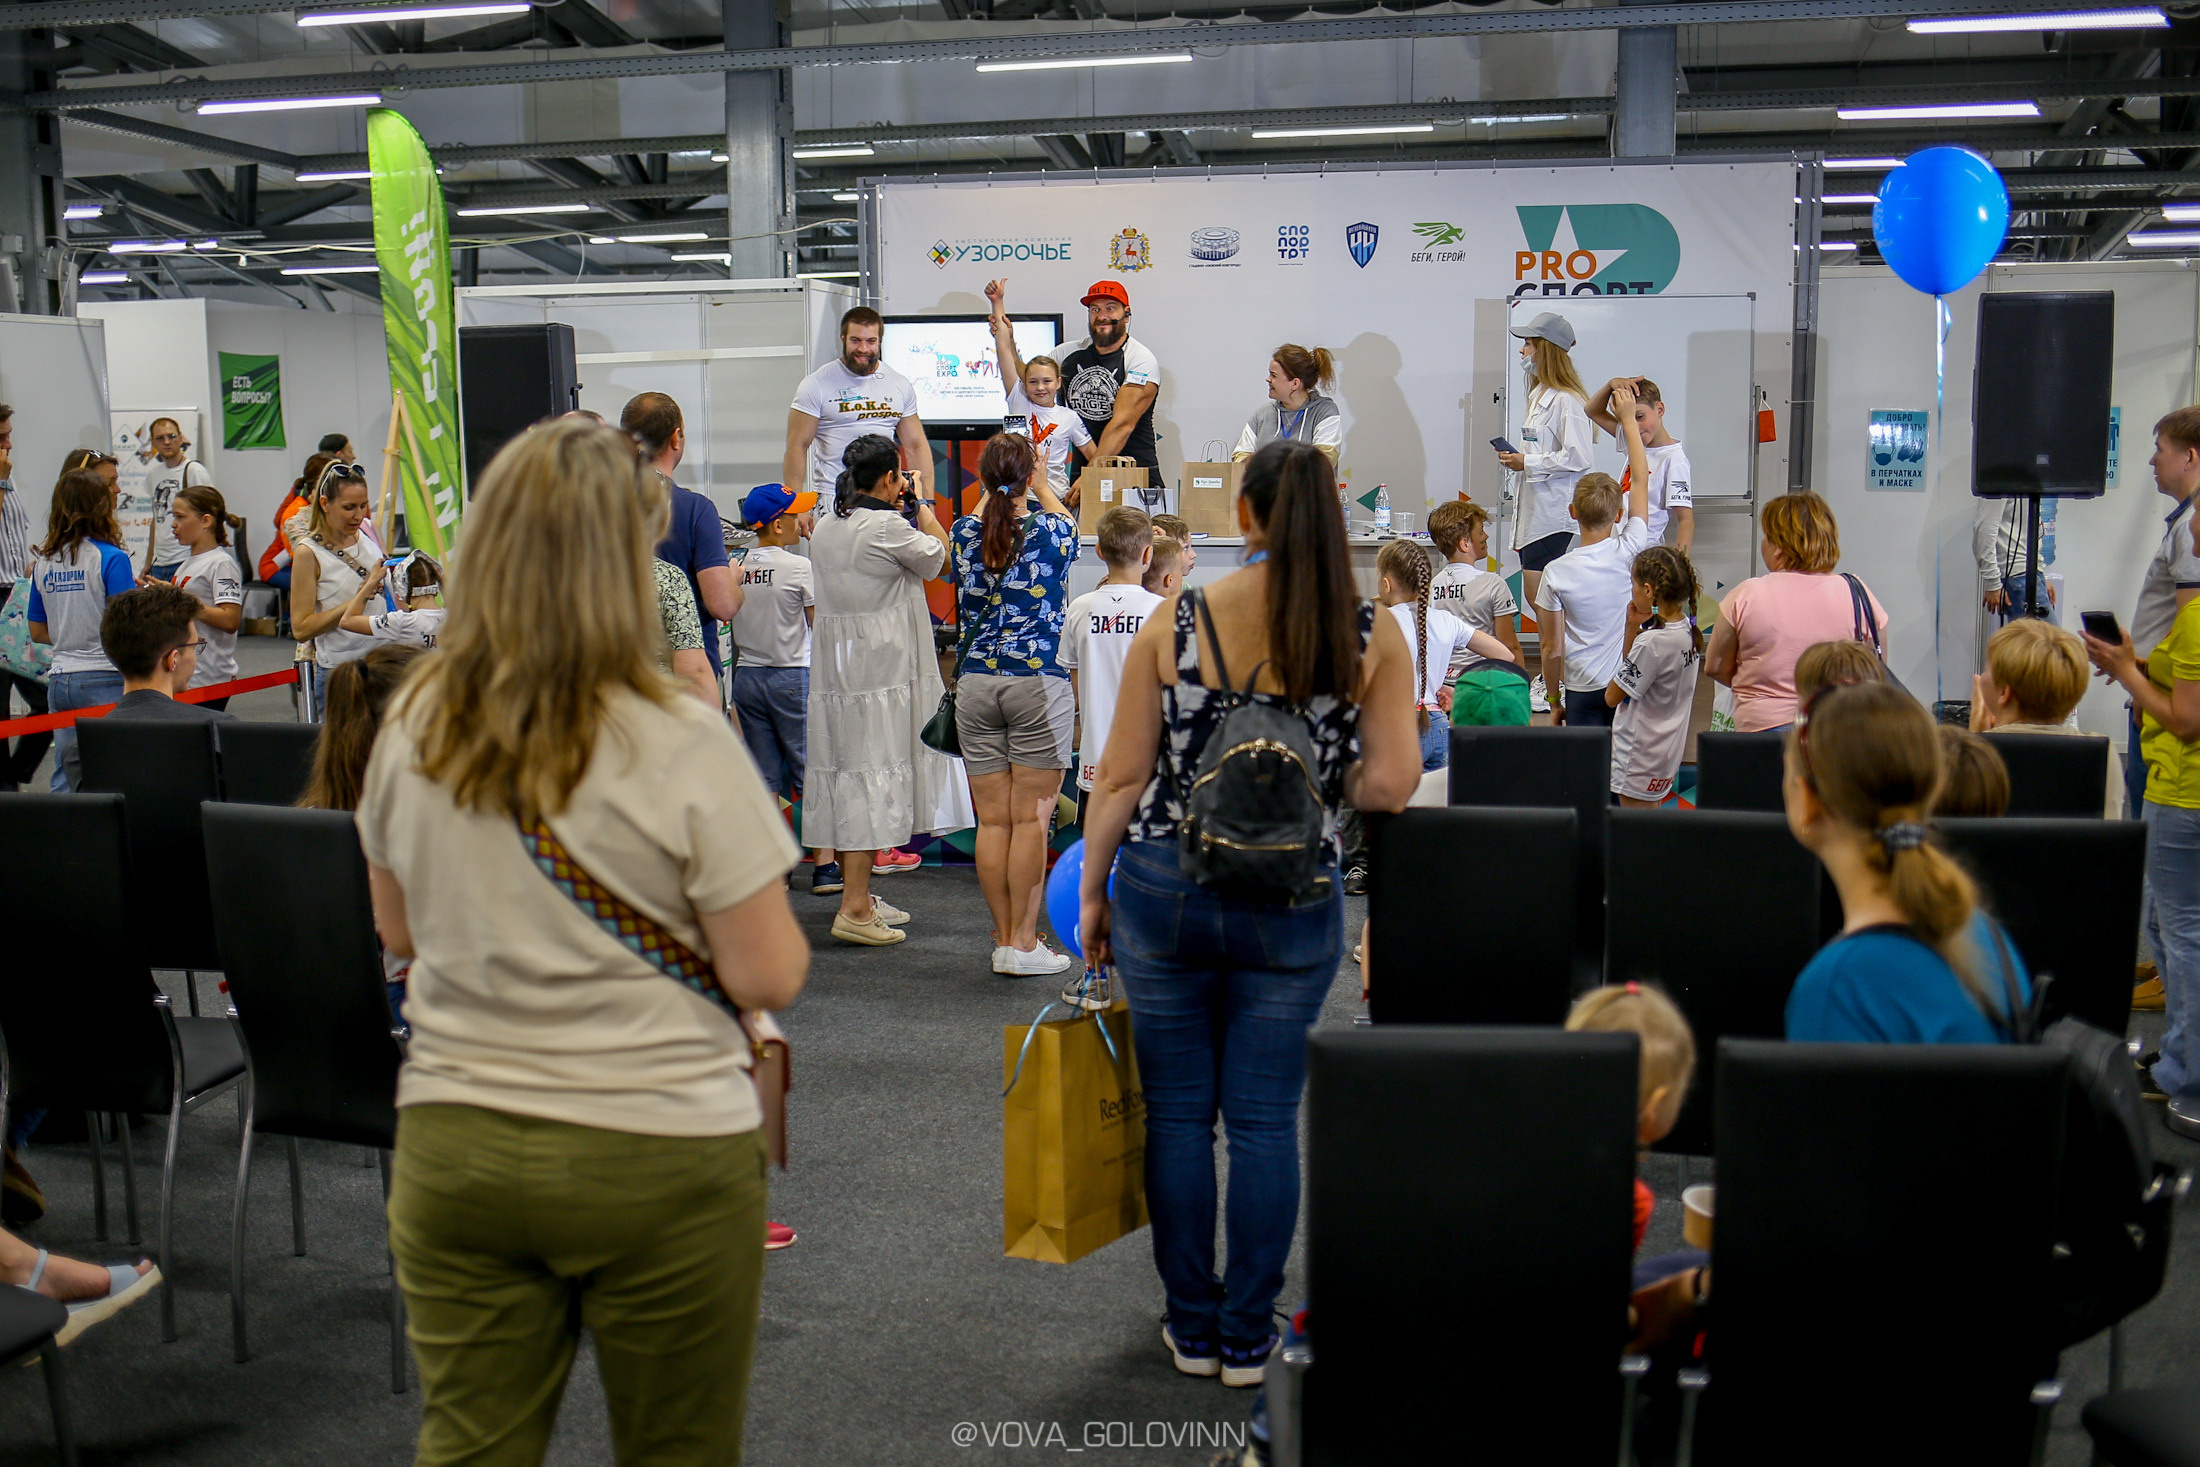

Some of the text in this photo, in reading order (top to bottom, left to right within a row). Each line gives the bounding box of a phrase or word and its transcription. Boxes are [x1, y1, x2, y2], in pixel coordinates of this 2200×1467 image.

[955, 243, 1071, 262] УЗОРОЧЬЕ
[1411, 250, 1466, 263] БЕГИ, ГЕРОЙ!
[1515, 250, 1597, 280] PRO
[232, 376, 252, 388] ЕСТЬ
[231, 391, 272, 404] ВОПРОСЫ?
[1886, 413, 1913, 422] ДОБРО
[1879, 469, 1922, 478] ПЕРЧАТКАХ
[1879, 479, 1913, 487] И МАСКЕ
[55, 570, 84, 582] ГАЗПРОМ
